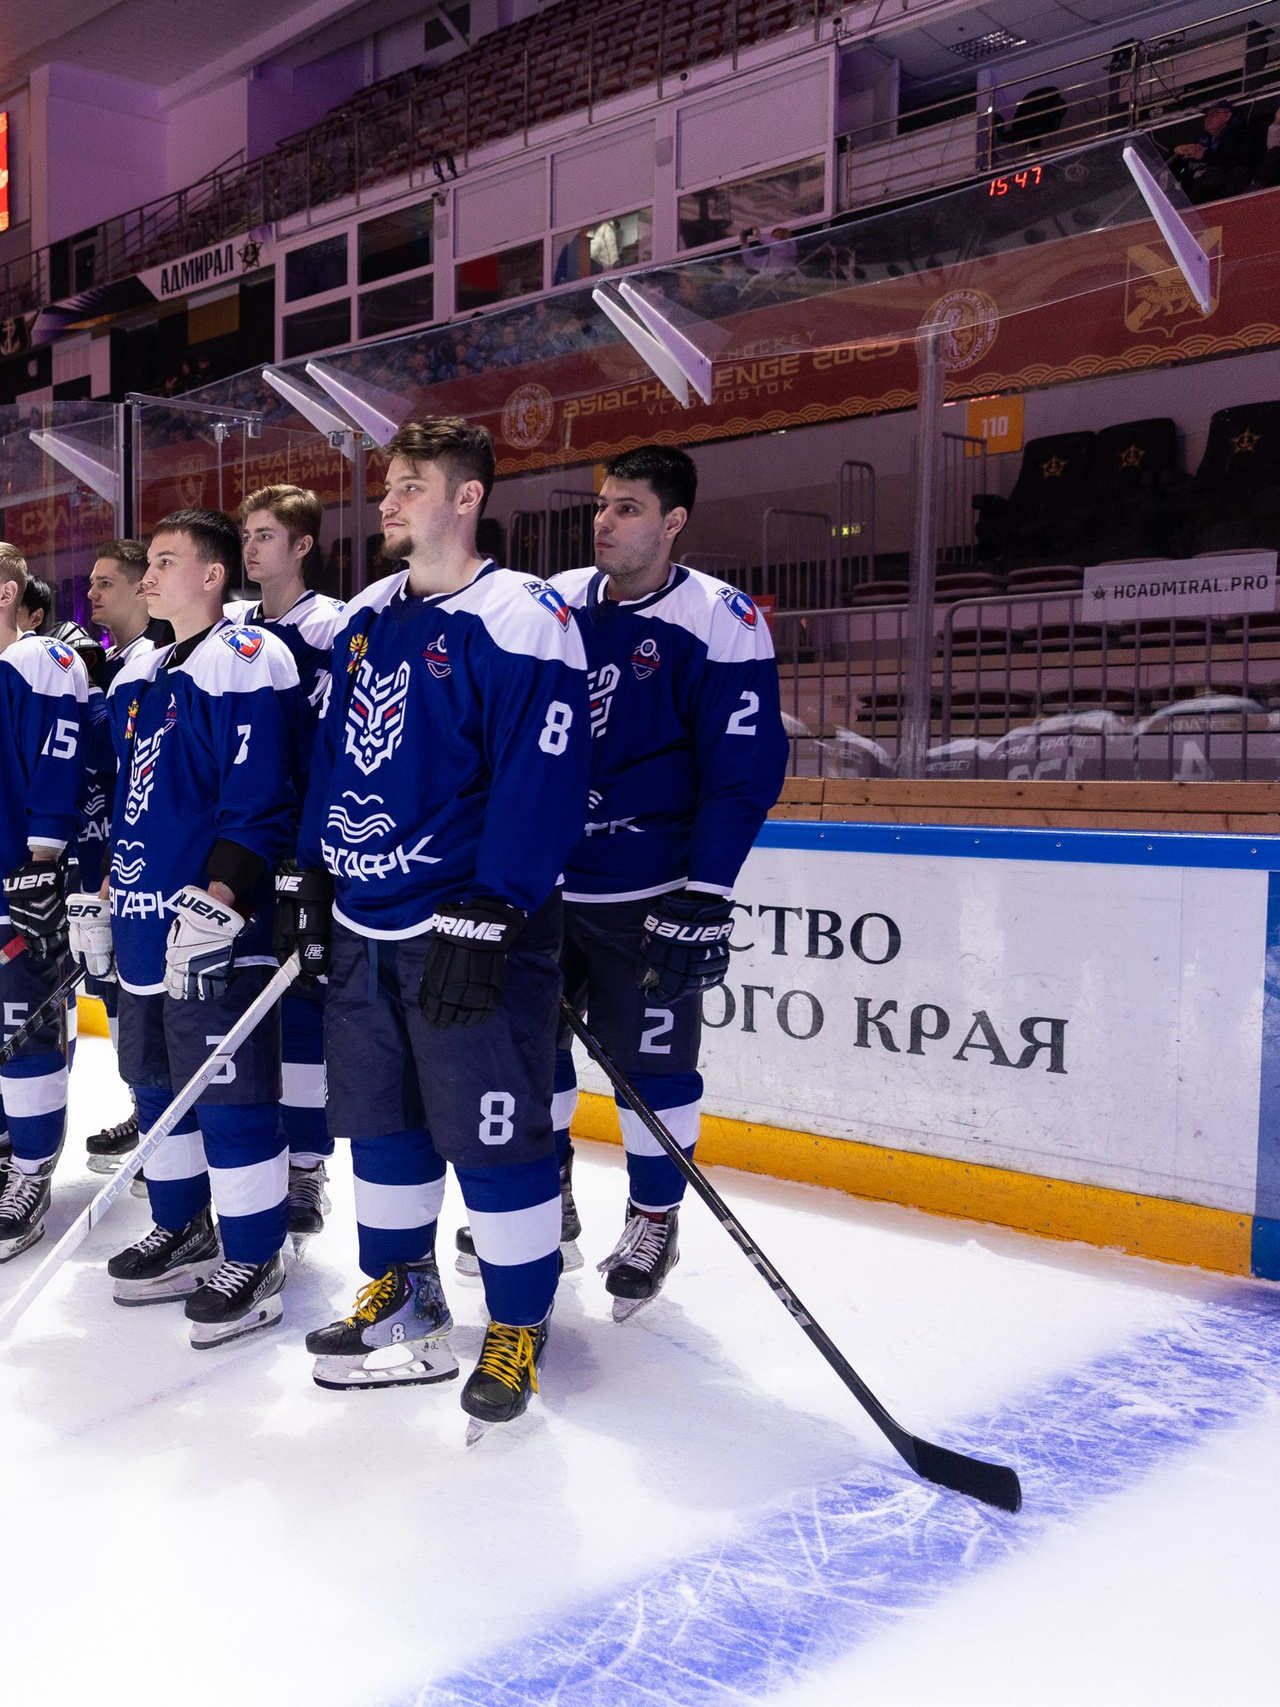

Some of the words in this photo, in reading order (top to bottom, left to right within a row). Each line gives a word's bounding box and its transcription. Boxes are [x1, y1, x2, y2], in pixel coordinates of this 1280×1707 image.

[161, 244, 234, 295] АДМИРАЛ
[981, 415, 1009, 438] 110
[1114, 575, 1269, 599] HCADMIRAL.PRO
[538, 701, 574, 756] 8
[725, 690, 760, 736] 2
[41, 718, 80, 760] 15
[431, 914, 507, 943] PRIME
[643, 914, 734, 943] BAUER
[638, 1008, 675, 1055] 2
[853, 996, 1069, 1075] КРАЯ
[479, 1091, 516, 1146] 8
[391, 1322, 406, 1342] 8
